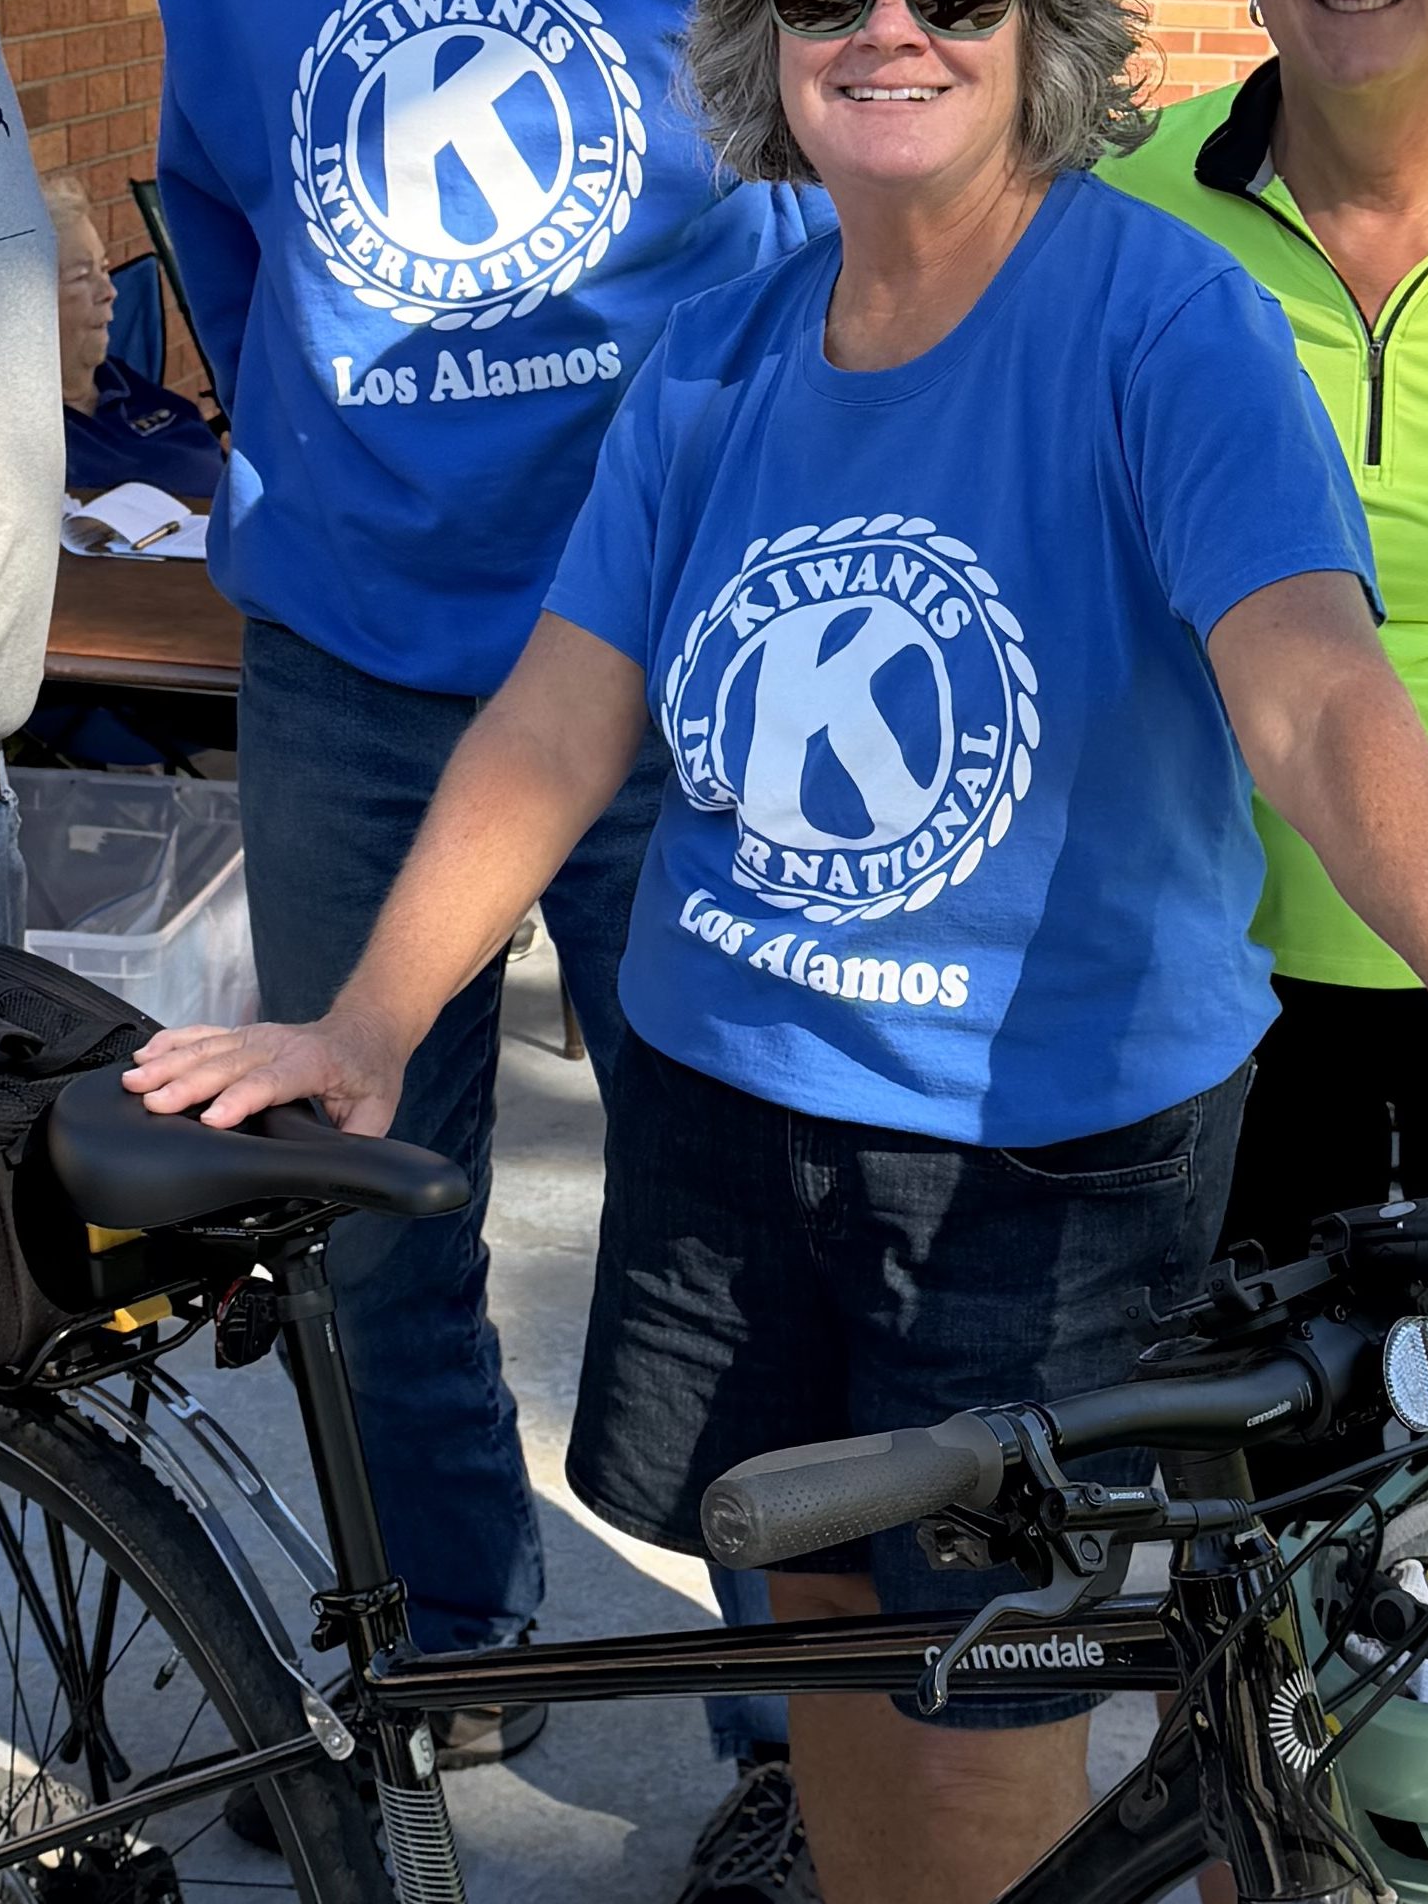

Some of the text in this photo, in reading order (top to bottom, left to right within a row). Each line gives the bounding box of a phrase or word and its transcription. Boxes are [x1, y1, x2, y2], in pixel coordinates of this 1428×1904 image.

[315, 135, 615, 299] INTERNATIONAL
[331, 341, 622, 407] Los Alamos
[730, 552, 972, 640] KIWANIS
[682, 716, 999, 895] INTRNATIONAL
[680, 888, 970, 1008] Los Alamos
[925, 1634, 1105, 1670] cnnondale
